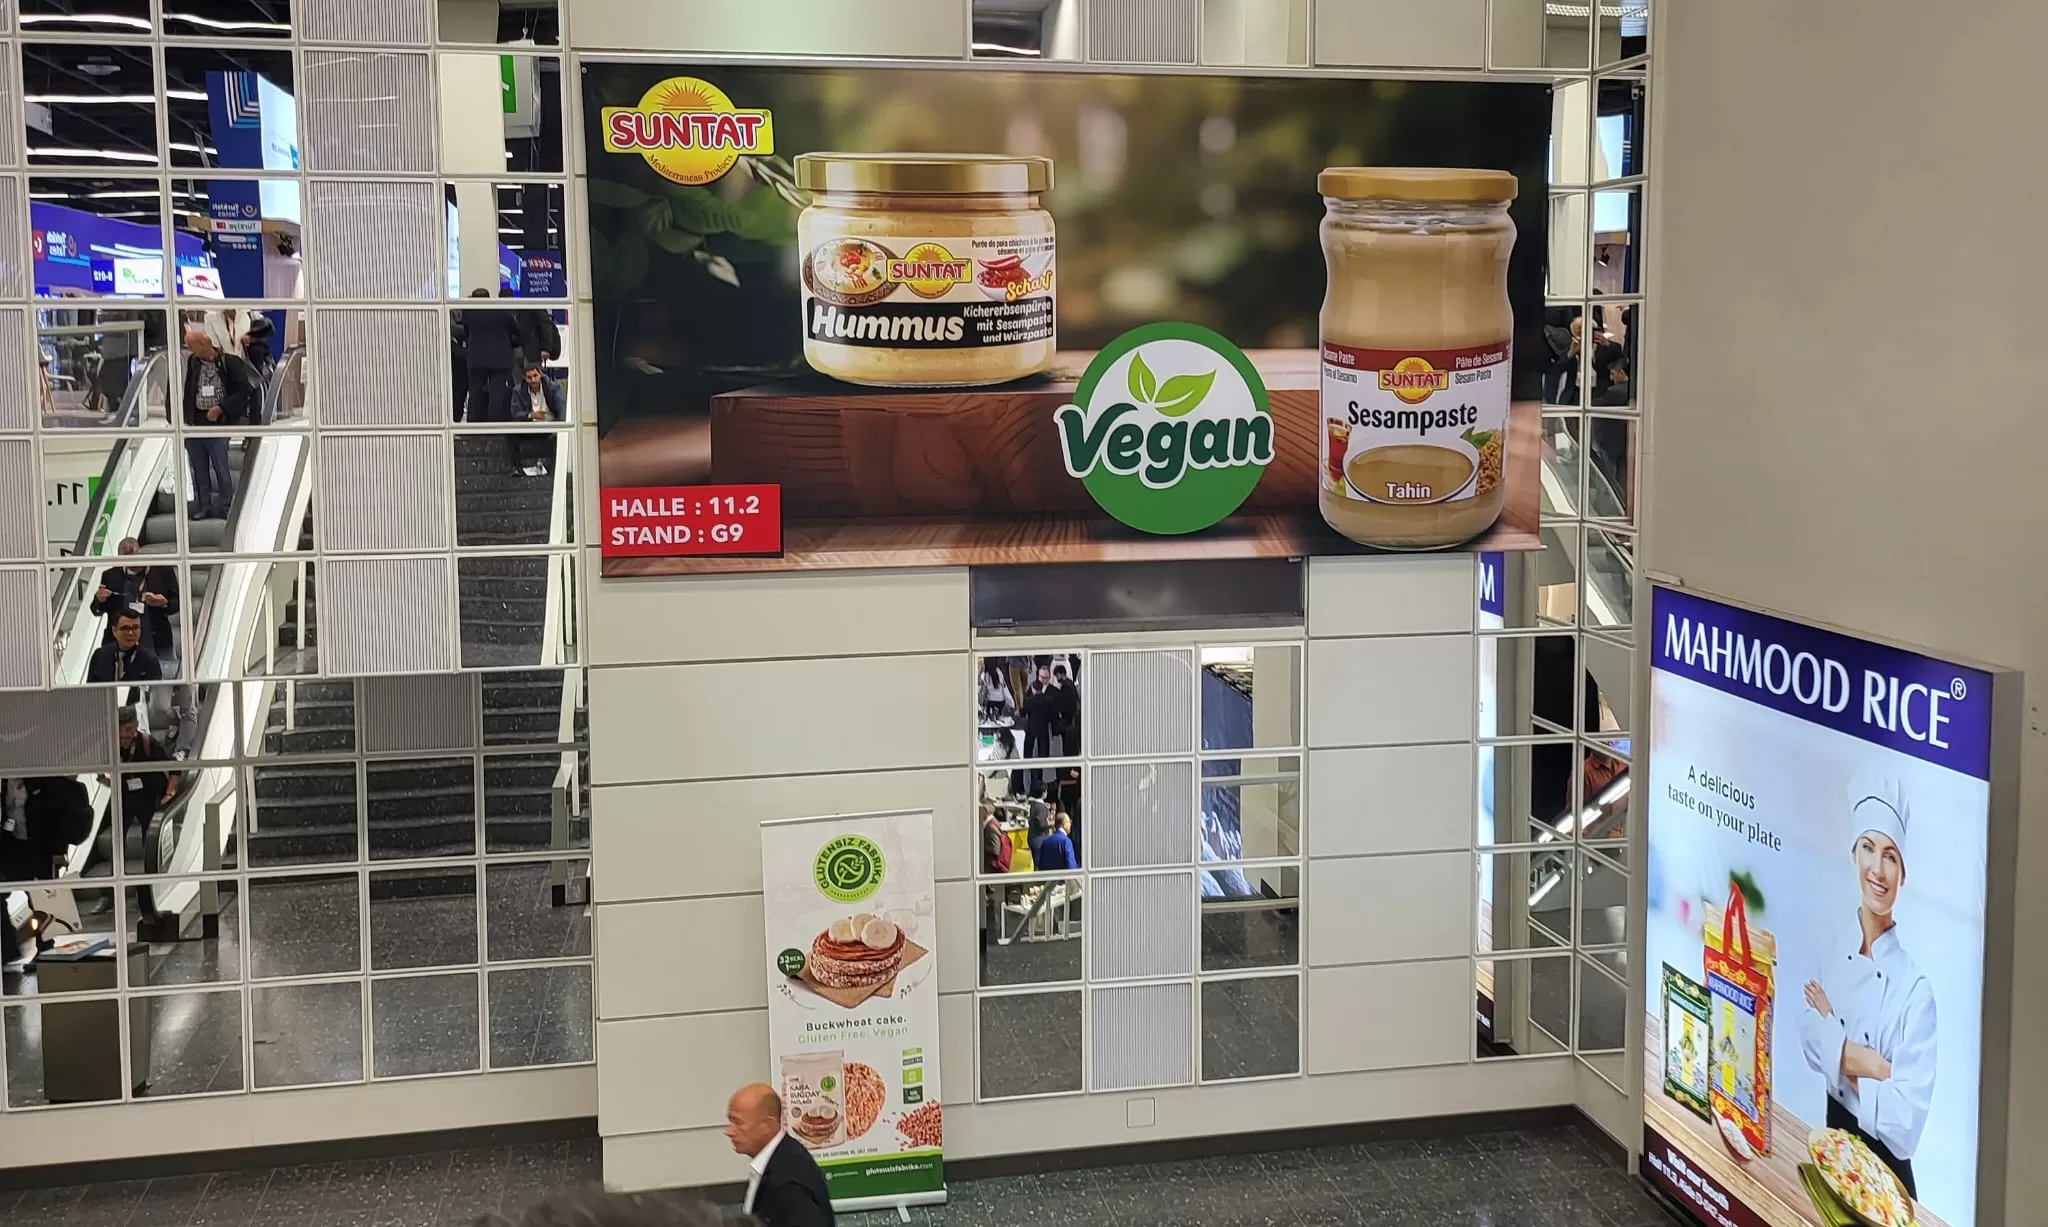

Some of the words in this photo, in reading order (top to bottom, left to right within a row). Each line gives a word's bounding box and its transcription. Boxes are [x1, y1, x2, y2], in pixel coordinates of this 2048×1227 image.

[609, 111, 764, 150] SUNTAT
[648, 153, 704, 182] Mediterranean
[704, 153, 734, 180] Products
[891, 262, 967, 280] SUNTAT
[1005, 270, 1053, 302] Scharf
[963, 299, 1052, 318] Kichererbsenpüree
[811, 304, 965, 342] Hummus
[976, 318, 994, 332] mit
[995, 313, 1052, 331] Sesampaste
[982, 332, 1002, 343] und
[1003, 326, 1053, 342] Würzpaste
[1382, 372, 1444, 388] SUNTAT
[1347, 399, 1478, 437] Sesampaste
[1058, 402, 1273, 485] Vegan
[1385, 482, 1432, 500] Tahin
[611, 497, 686, 518] HALLE
[708, 495, 760, 515] 11.2
[611, 525, 691, 546] STAND
[710, 523, 744, 544] G9
[1664, 612, 1850, 714] MAHMOOD
[1687, 764, 1697, 784] A
[1699, 769, 1756, 810] delicious
[1667, 783, 1696, 811] taste
[1697, 800, 1714, 821] on
[1716, 808, 1745, 834] your
[1747, 822, 1783, 853] plate
[797, 1033, 837, 1045] Gluten
[872, 1026, 909, 1038] Vegan
[806, 1017, 872, 1032] Buckwheat
